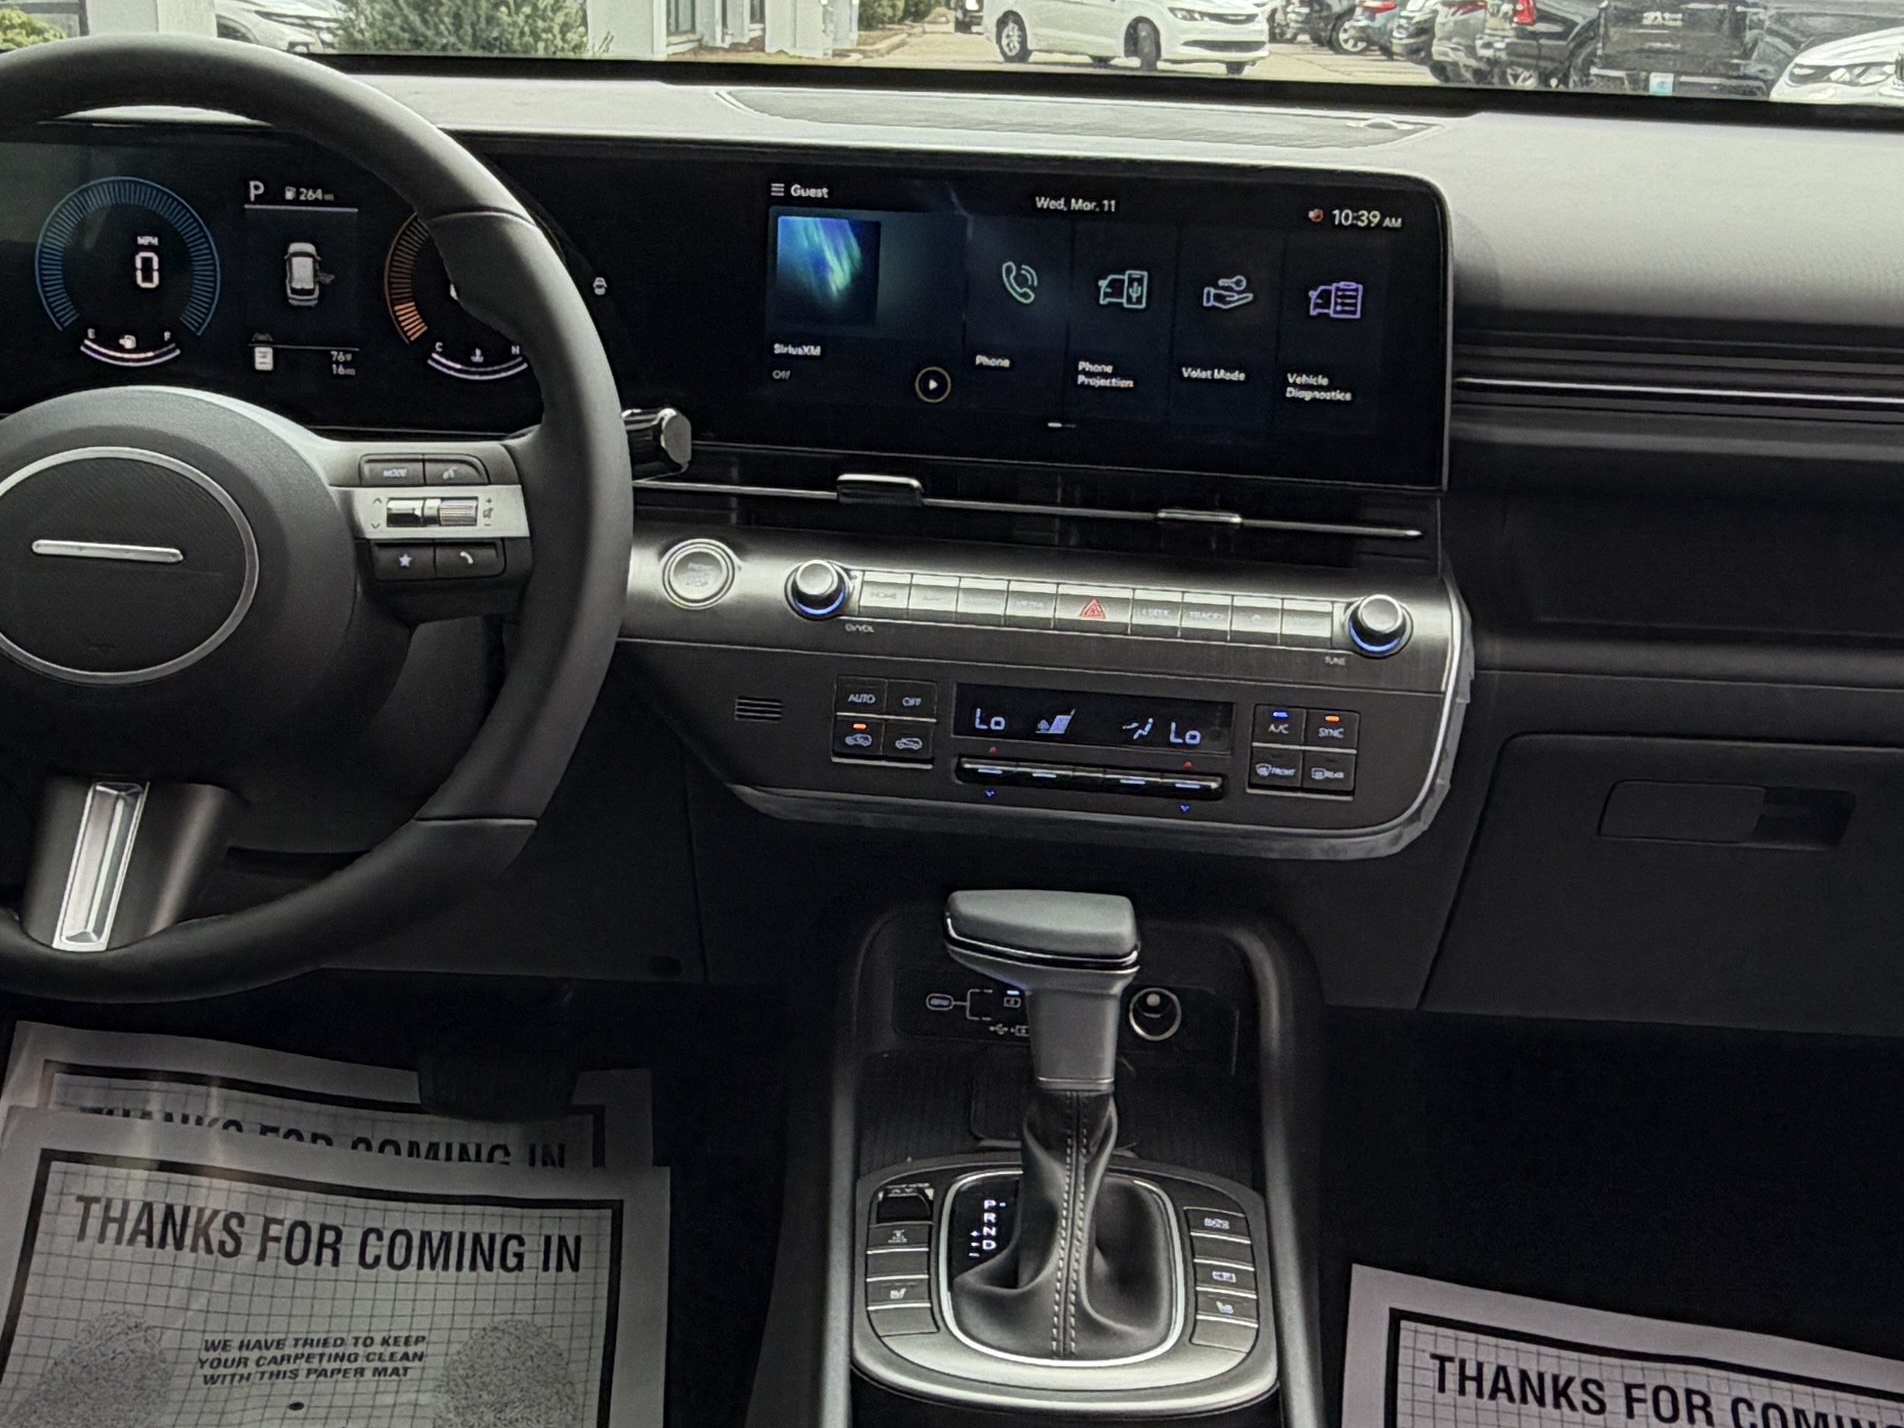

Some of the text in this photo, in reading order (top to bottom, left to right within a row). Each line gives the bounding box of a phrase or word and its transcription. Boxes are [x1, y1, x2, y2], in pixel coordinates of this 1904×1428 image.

[248, 180, 265, 202] P
[789, 183, 830, 199] Guest
[1035, 195, 1117, 213] Wed, Mar. 11
[1331, 208, 1403, 229] 10:39 AM
[136, 235, 160, 247] MPH
[134, 251, 161, 290] 0
[434, 341, 444, 353] C
[773, 342, 822, 357] SiriusXM
[974, 354, 1011, 369] Phone
[1077, 360, 1114, 375] Phone
[771, 369, 791, 381] Off
[1181, 366, 1247, 382] Valet Mode
[1286, 372, 1330, 387] Vehicle
[1076, 374, 1135, 390] Projection
[1285, 386, 1353, 403] Diagnostics
[1325, 655, 1347, 666] TUNE
[847, 693, 877, 706] AUTO
[901, 695, 922, 708] OFF
[974, 707, 1007, 731] Lo
[1168, 721, 1202, 746] Lo
[1267, 723, 1290, 735] A/C
[1317, 726, 1345, 739] SYNC
[1270, 766, 1297, 777] FRONT
[983, 1198, 997, 1211] P
[983, 1211, 997, 1224] R
[73, 1194, 583, 1274] THANKS FOR COMING IN
[982, 1225, 997, 1237] N
[981, 1239, 998, 1251] D
[203, 1334, 428, 1354] WE HAVE TRIED TO KEEP
[197, 1350, 426, 1371] YOUR CARPETING CLEAN
[202, 1365, 413, 1387] WITH THIS PAPER MAT
[1428, 1351, 1608, 1417] THANKS
[1622, 1381, 1715, 1428] FOR
